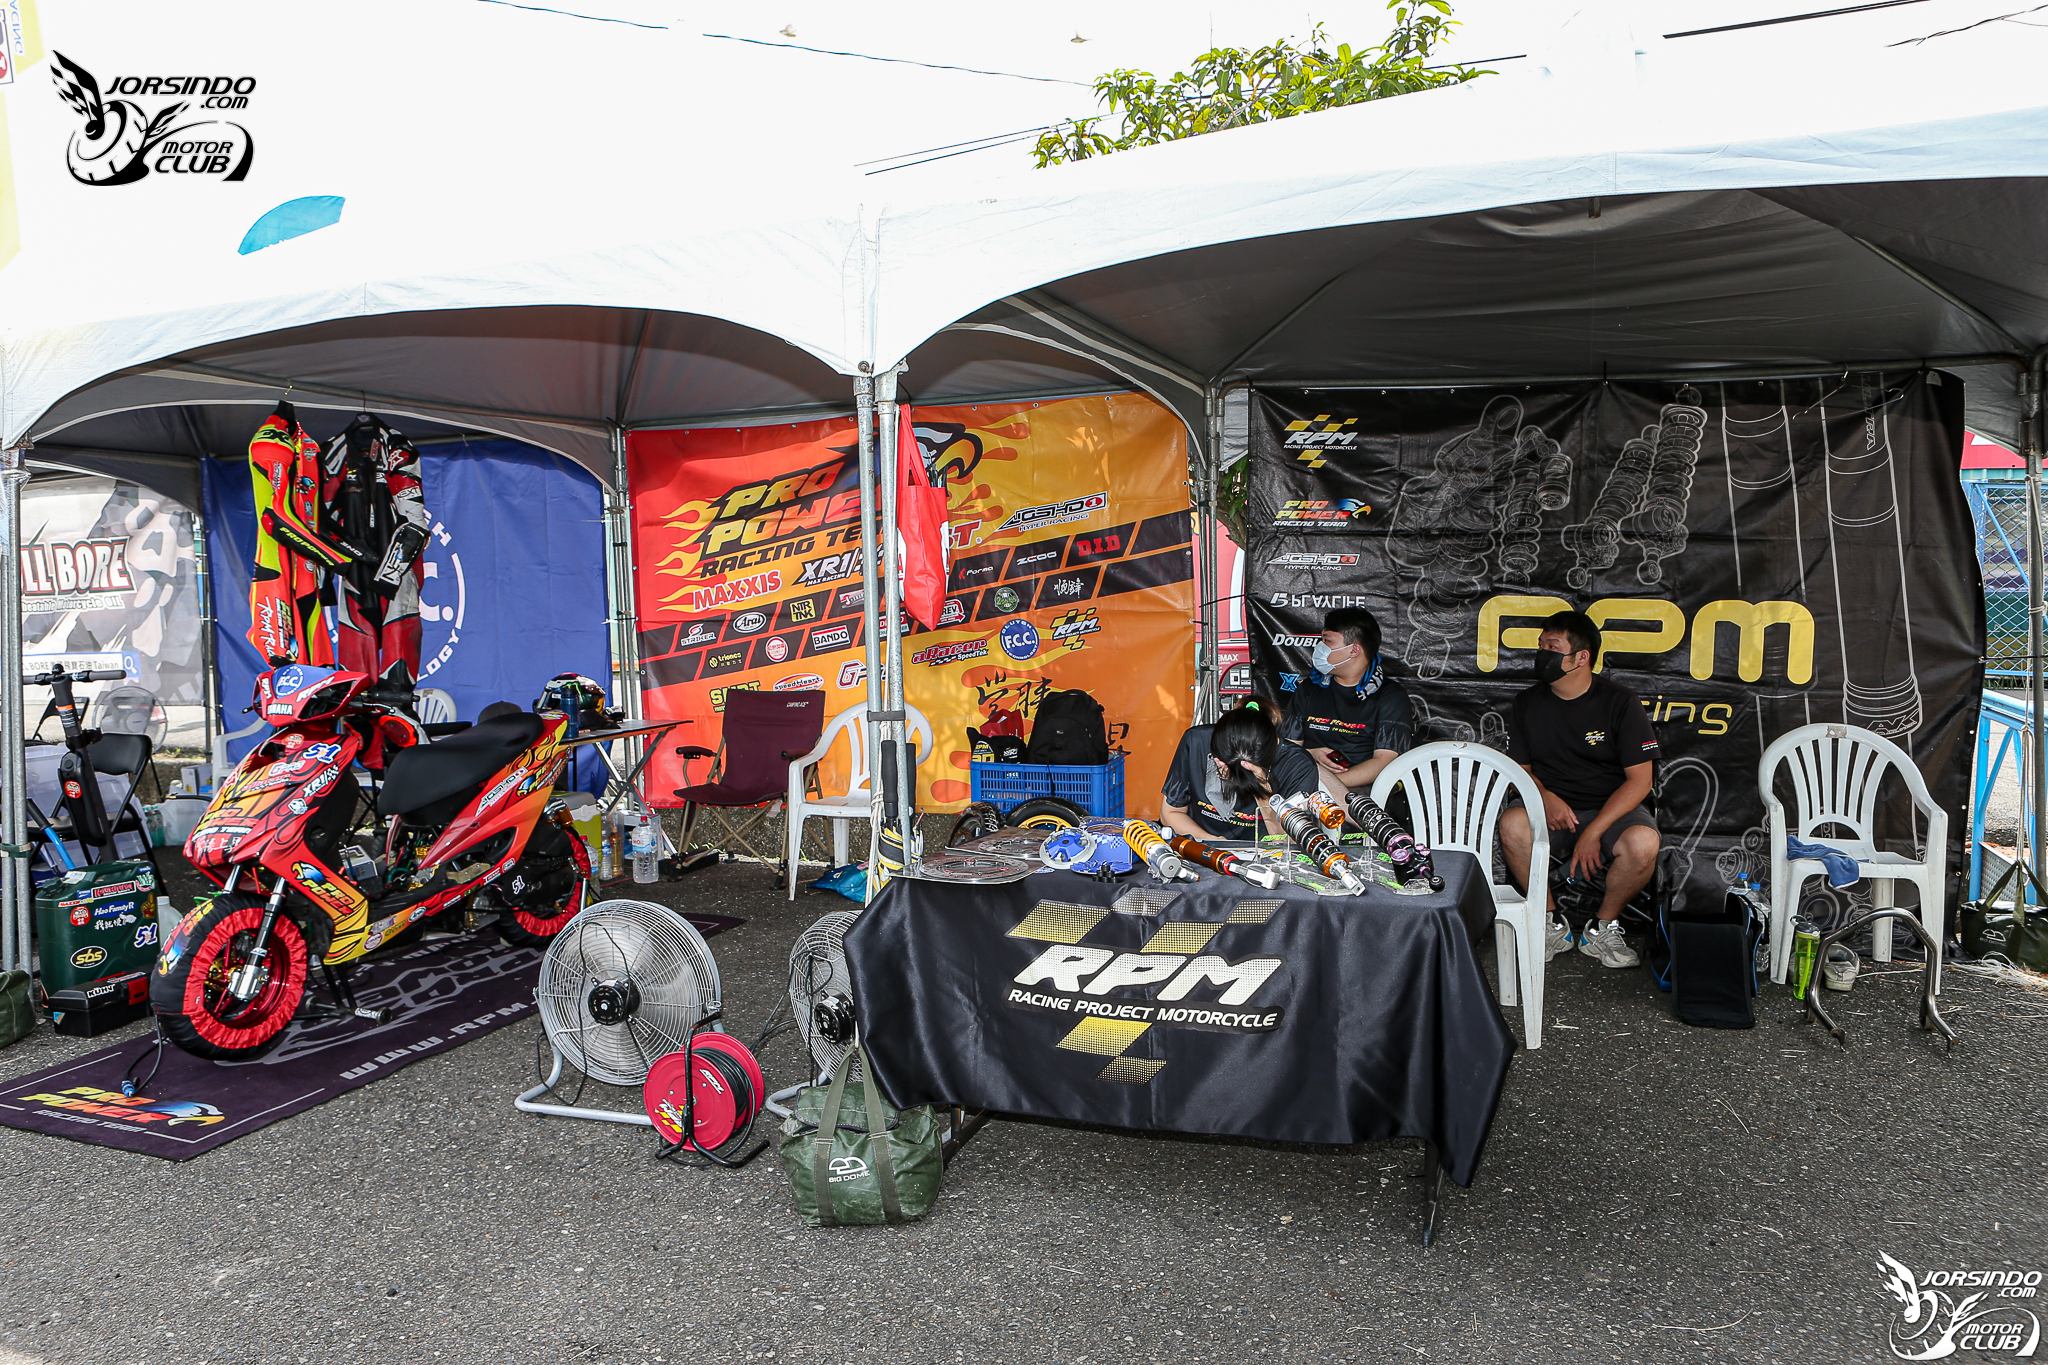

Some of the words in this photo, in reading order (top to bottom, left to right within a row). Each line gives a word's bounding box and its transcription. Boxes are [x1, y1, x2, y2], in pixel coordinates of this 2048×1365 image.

[1285, 432, 1358, 445] RPM
[719, 461, 845, 518] PRO
[1283, 500, 1329, 509] PRO
[706, 484, 881, 554] POWE
[1018, 521, 1047, 532] HYPER
[1049, 513, 1089, 526] RACING
[1275, 511, 1351, 520] POWER
[280, 527, 302, 543] PRO
[699, 533, 815, 578] RACING
[53, 540, 133, 593] BORE
[806, 577, 821, 586] MAX
[822, 573, 846, 582] RACING
[693, 570, 782, 612] MAXXIS
[1053, 617, 1099, 637] RPM
[681, 632, 715, 645] STRIKER
[813, 631, 848, 645] BANDO
[957, 649, 988, 662] SpeedTek
[1641, 694, 1733, 735] ing
[303, 743, 341, 764] 51
[302, 879, 353, 915] POWER
[321, 882, 355, 905] PRO
[94, 907, 109, 916] Hao
[134, 923, 158, 948] 51
[75, 948, 103, 965] sbs
[1013, 944, 1283, 1005] RPM
[1008, 988, 1071, 1011] RACING
[1073, 999, 1154, 1021] PROJECT
[1156, 1008, 1278, 1028] MOTORCYCLE
[57, 1086, 156, 1106] PRO
[17, 1093, 173, 1123] POWER
[32, 1109, 99, 1124] RACING
[97, 1121, 148, 1133] TEAM
[843, 1170, 870, 1181] DOME
